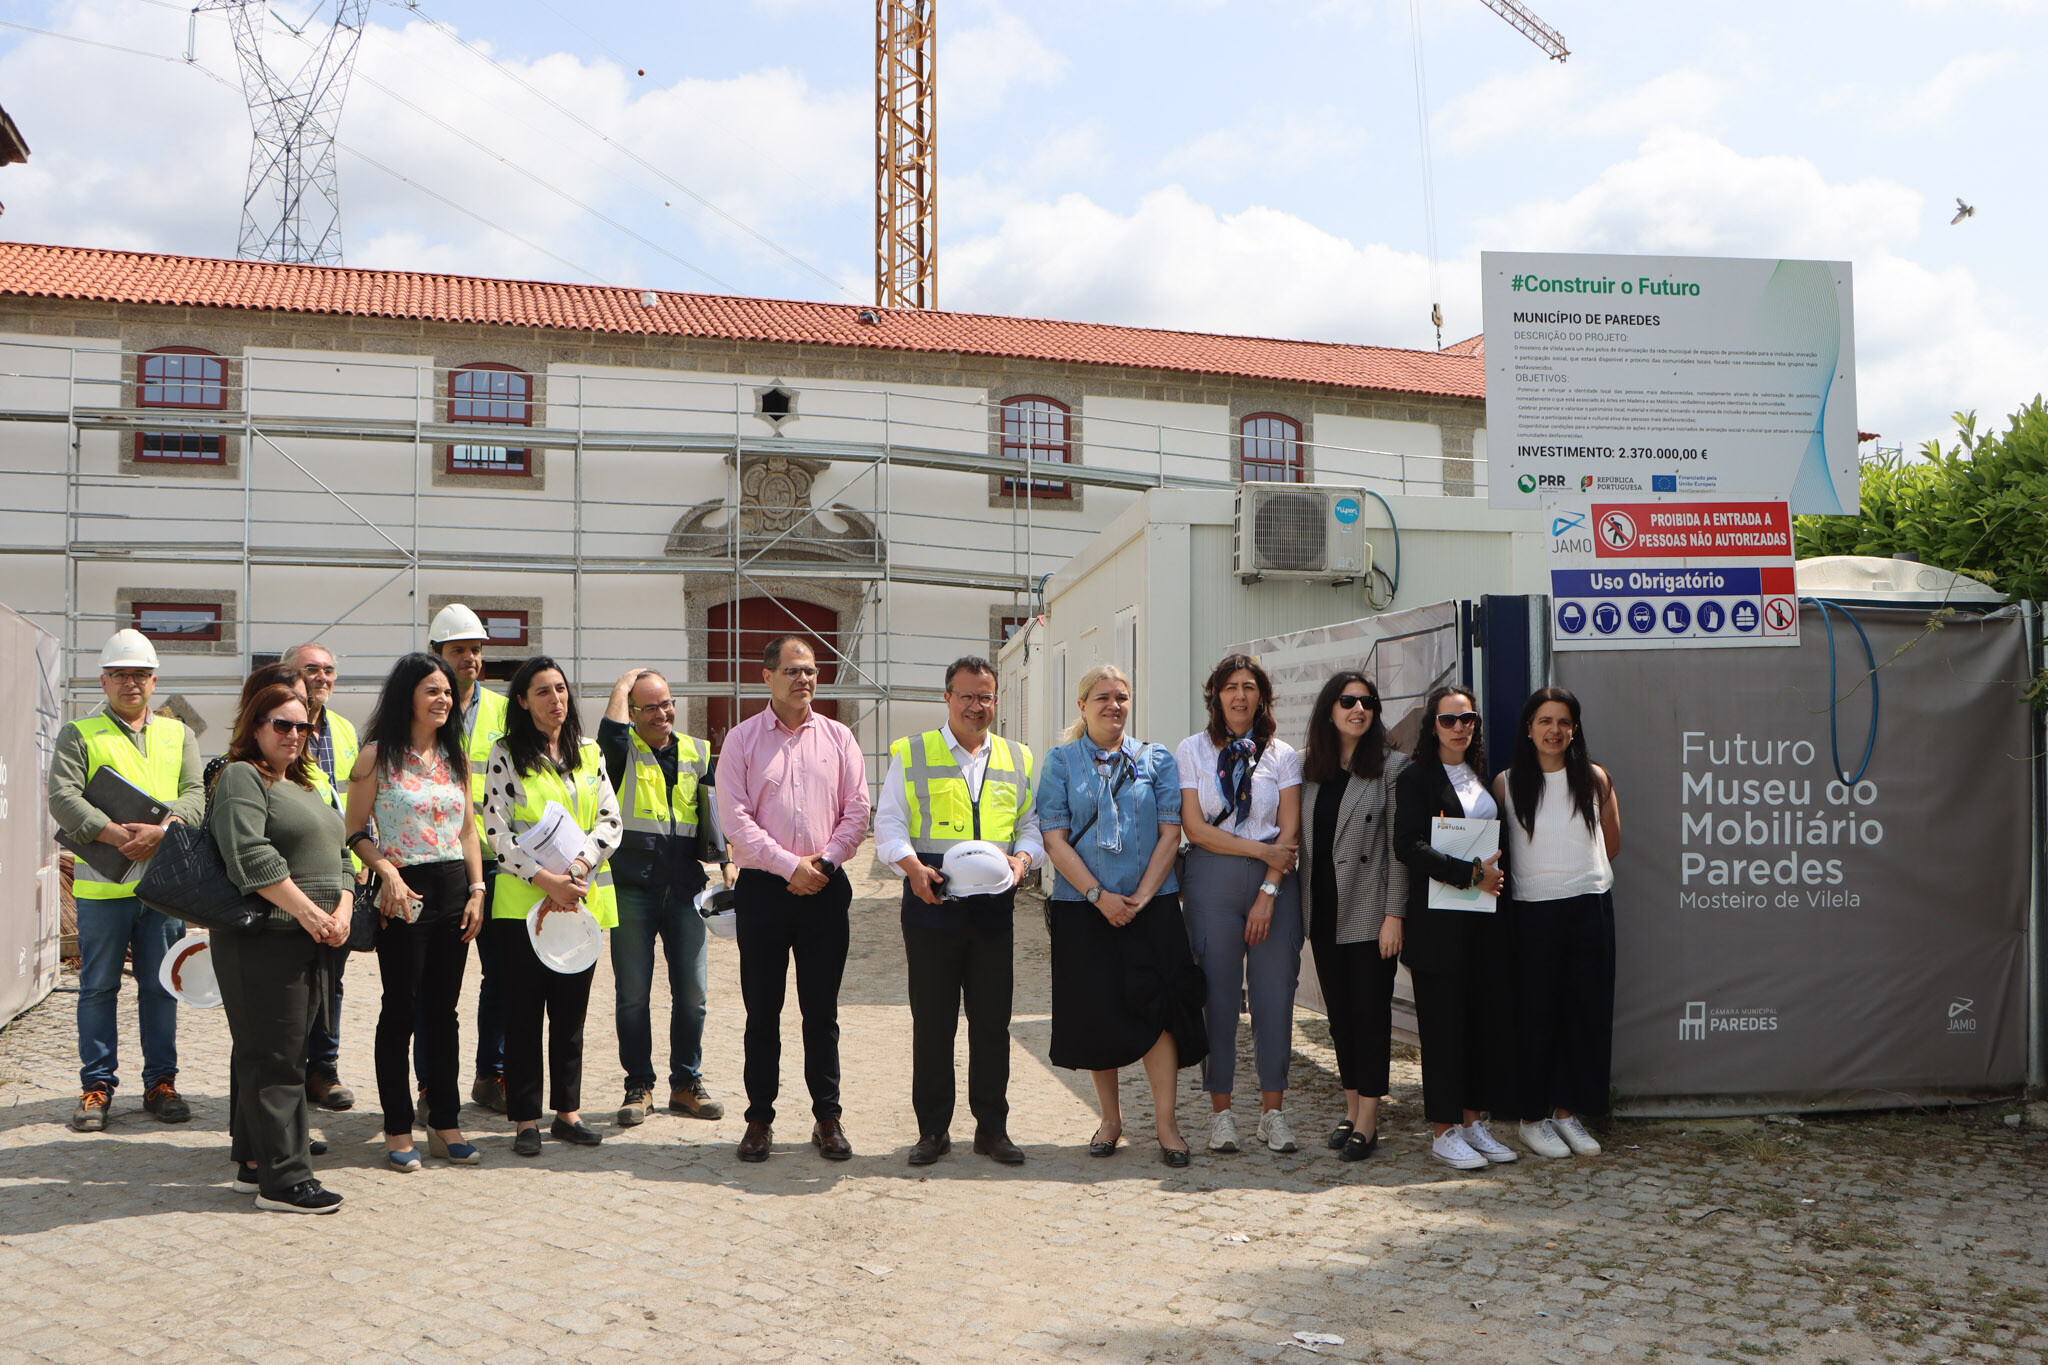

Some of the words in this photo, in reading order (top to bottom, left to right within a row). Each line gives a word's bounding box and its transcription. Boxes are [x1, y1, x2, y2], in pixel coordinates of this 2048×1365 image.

[1511, 275, 1615, 294] #Construir
[1621, 282, 1633, 294] o
[1639, 278, 1700, 296] Futuro
[1513, 310, 1582, 324] MUNICÍPIO
[1585, 314, 1601, 325] DE
[1605, 314, 1661, 326] PAREDES
[1514, 331, 1567, 342] DESCRIÇÃO
[1569, 333, 1582, 341] DO
[1584, 333, 1629, 342] PROJETO:
[1515, 374, 1570, 383] OBJETIVOS:
[1518, 446, 1615, 458] INVESTIMENTO:
[1618, 448, 1698, 461] 2.370.000,00
[1701, 449, 1708, 460] €
[1538, 474, 1566, 486] PRR
[1597, 475, 1634, 484] REPÚBLICA
[1597, 483, 1642, 491] PORTUGUESA
[1650, 513, 1701, 527] PROIBIDA
[1703, 513, 1711, 526] A
[1712, 513, 1762, 526] ENTRADA
[1764, 513, 1772, 525] A
[1552, 538, 1592, 554] JAMO
[1639, 533, 1688, 547] PESSOAS
[1690, 531, 1712, 547] NÃO
[1715, 533, 1787, 546] AUTORIZADAS
[1590, 572, 1624, 590] Uso
[1629, 572, 1725, 593] Obrigatório
[1682, 731, 1816, 766] Futuro
[1682, 771, 1811, 805] Museu
[1826, 771, 1878, 805] do
[1681, 811, 1884, 845] Mobiliário
[1681, 851, 1844, 885] Paredes
[1680, 891, 1768, 909] Mosteiro
[1774, 890, 1799, 908] de
[1806, 890, 1860, 907] Vilela
[1710, 1017, 1778, 1031] PAREDES
[1947, 1018, 1976, 1031] JAMO
